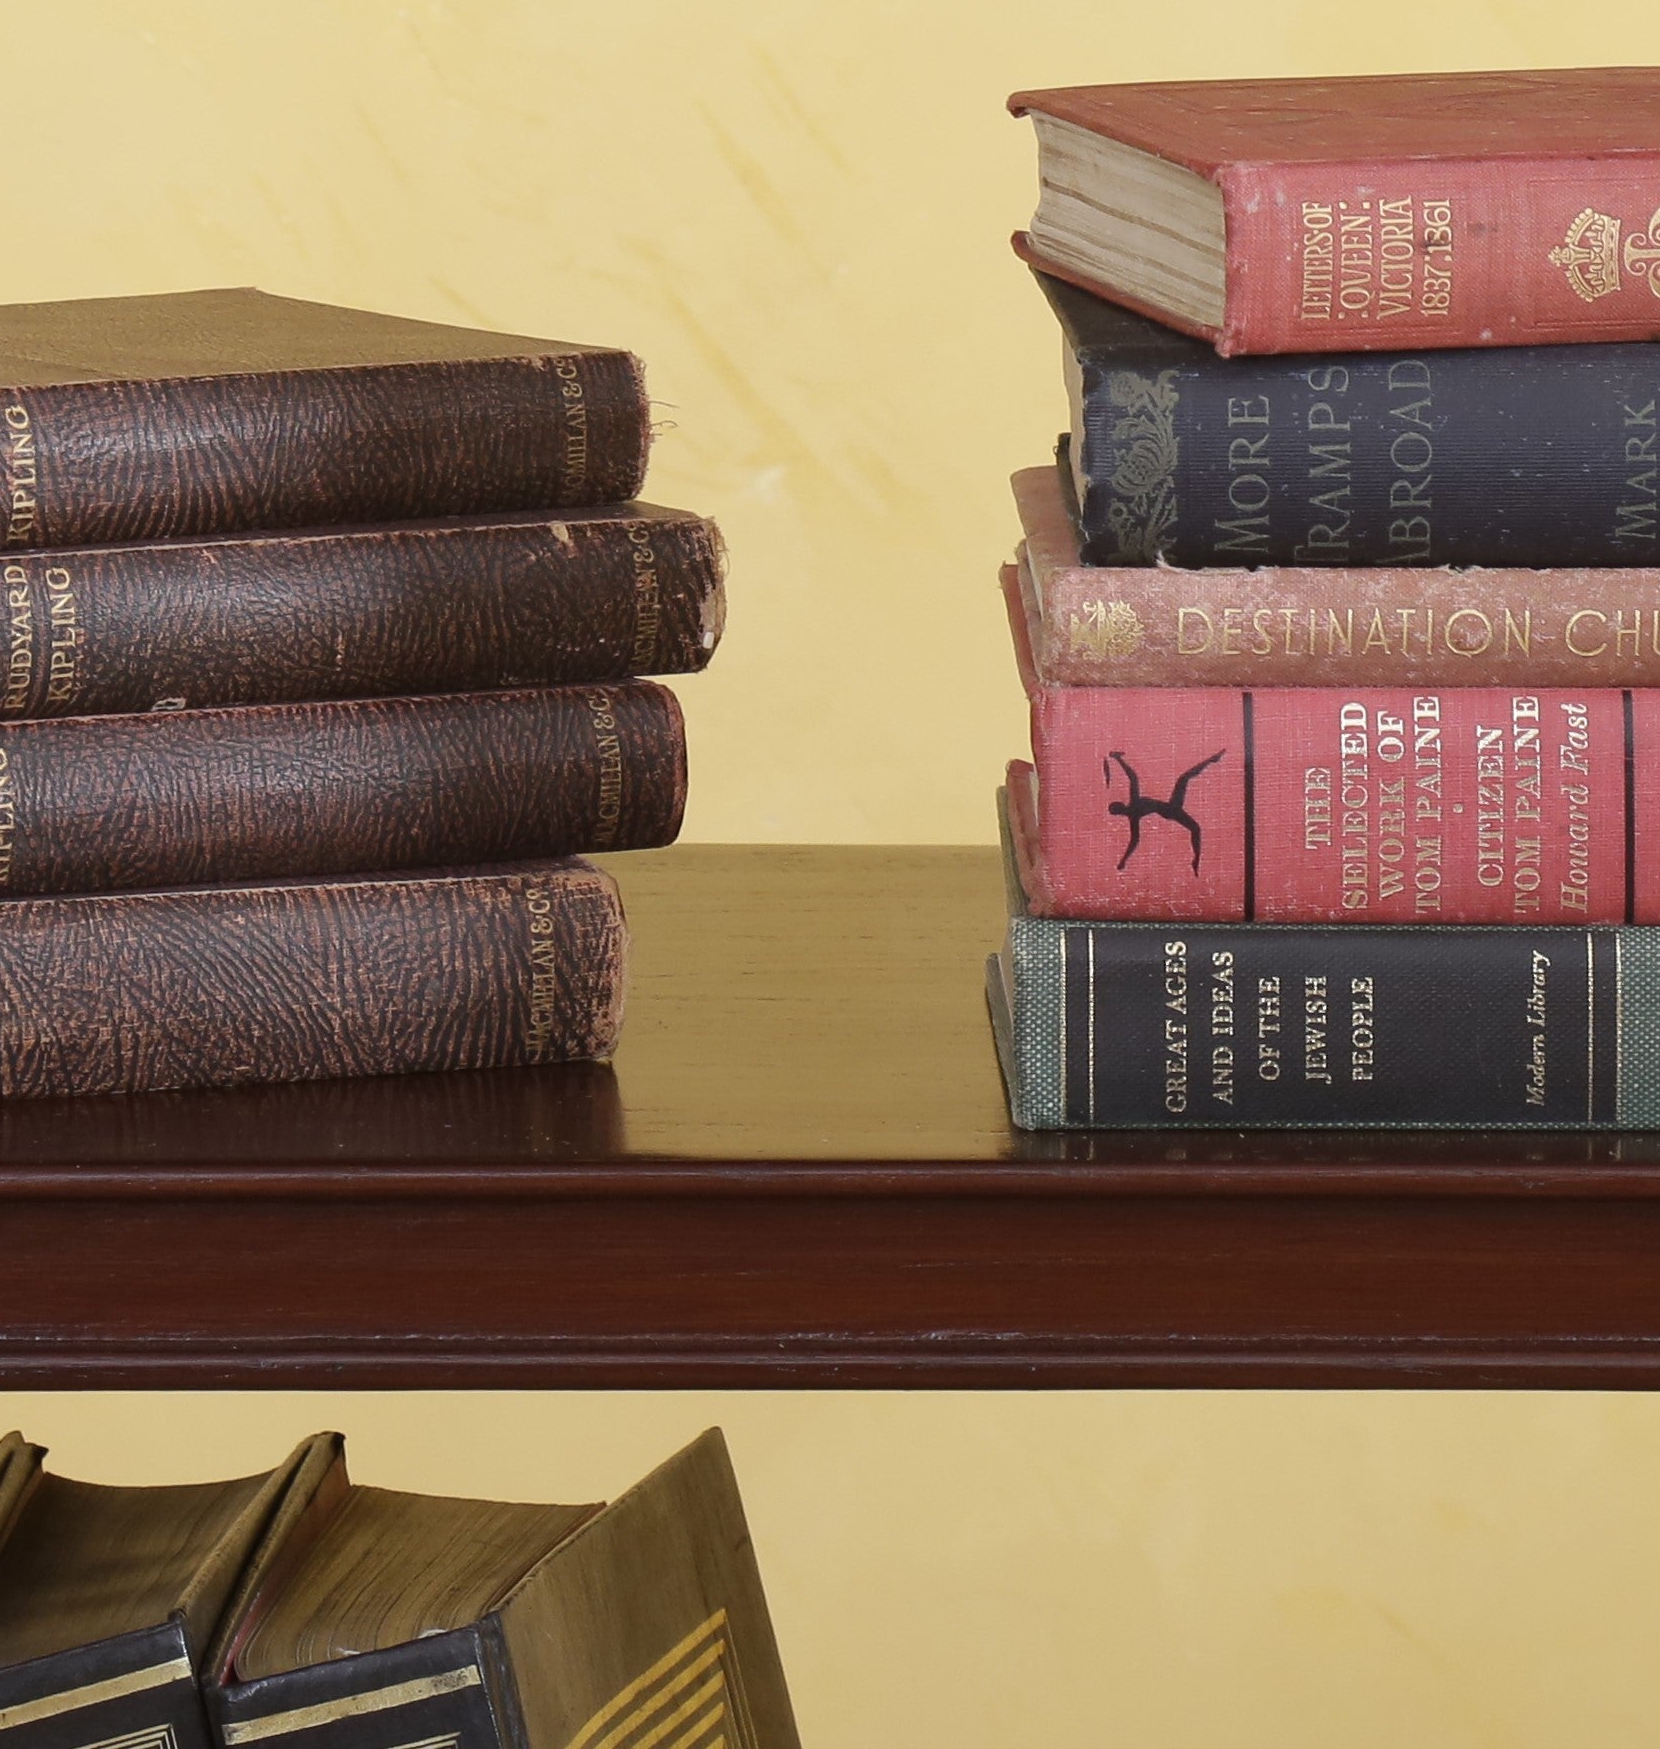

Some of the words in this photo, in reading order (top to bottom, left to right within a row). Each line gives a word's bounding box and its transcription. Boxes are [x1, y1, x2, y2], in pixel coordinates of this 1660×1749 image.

[1377, 195, 1415, 319] VICTORIA
[6, 404, 37, 543] KIPLING
[1214, 394, 1271, 552] MORE
[1616, 399, 1657, 540] MARK
[3, 565, 32, 711] RUDYARD
[46, 566, 77, 704] KIPLING
[1177, 607, 1531, 657] DESTINATION
[1377, 710, 1406, 763] OF
[1413, 695, 1441, 822] PAINE
[1513, 695, 1540, 823] PAINE
[1559, 701, 1590, 777] Fast
[1305, 765, 1333, 849] THE
[1340, 701, 1369, 910] SELECTED
[1377, 776, 1406, 900] WORK
[1476, 724, 1505, 887] CITIZEN
[1560, 776, 1590, 913] Howard
[1415, 838, 1441, 914] TOM
[1514, 838, 1541, 914] TOM
[1165, 939, 1188, 1015] AGES
[1212, 950, 1235, 1037] IDEAS
[1258, 975, 1281, 1042] THE
[1525, 950, 1552, 1026] Library
[1165, 1018, 1188, 1115] GREAT
[1212, 1043, 1236, 1105] AND
[1258, 1044, 1281, 1082] OF
[1305, 974, 1332, 1084] JEWISH
[1351, 976, 1374, 1082] PEOPLE
[1525, 1028, 1546, 1107] Modern
